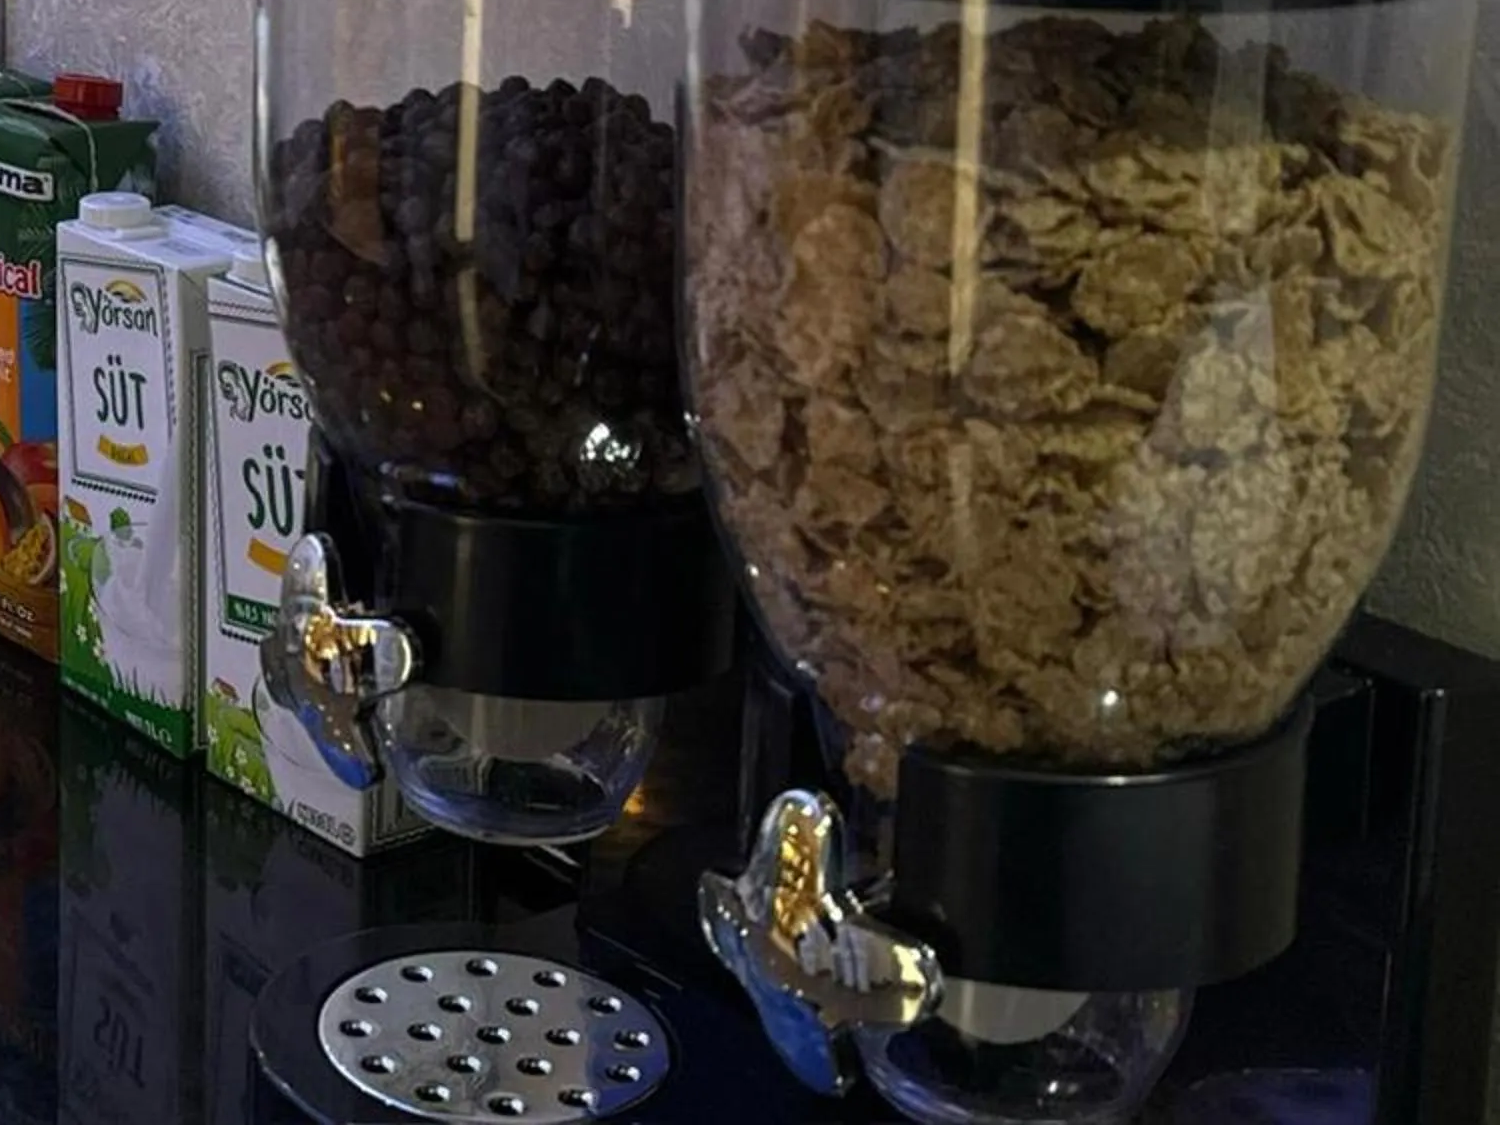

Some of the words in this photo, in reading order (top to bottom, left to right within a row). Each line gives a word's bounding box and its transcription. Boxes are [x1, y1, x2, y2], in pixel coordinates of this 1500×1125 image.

[85, 286, 160, 338] Yörsan
[93, 354, 147, 431] SÜT
[240, 365, 313, 423] Yörs
[243, 444, 307, 538] SÜ
